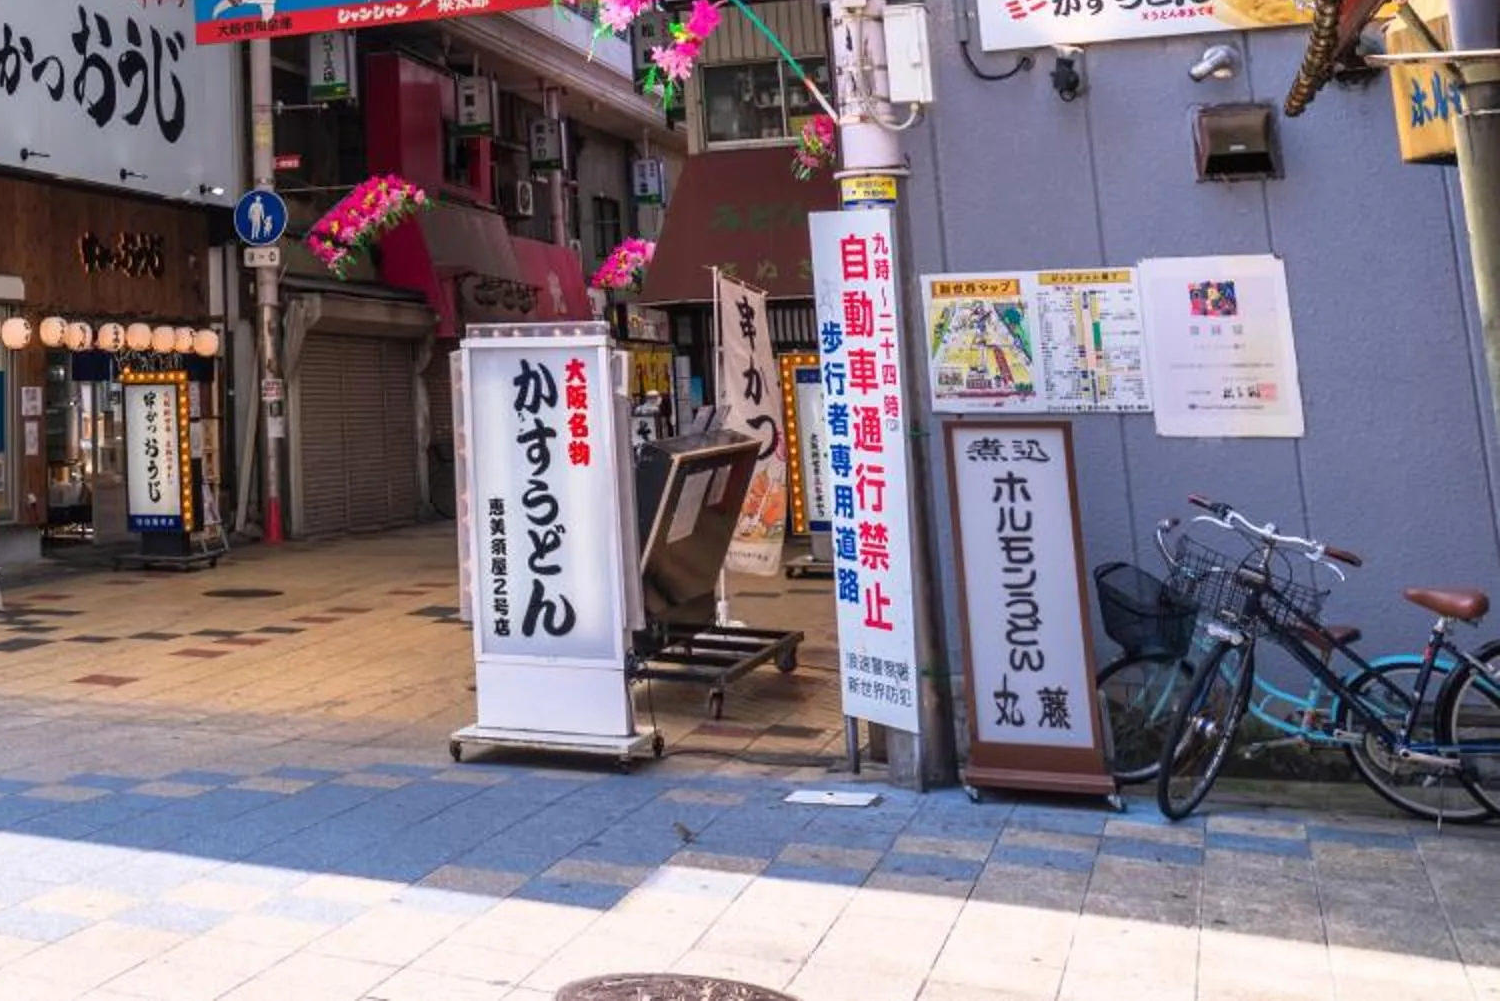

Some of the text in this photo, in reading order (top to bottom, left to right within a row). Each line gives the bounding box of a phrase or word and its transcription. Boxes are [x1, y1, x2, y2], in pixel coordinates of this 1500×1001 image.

[513, 358, 577, 638] かすうどん
[565, 357, 591, 467] 大阪名物
[820, 320, 860, 605] 歩行者専用道路
[840, 234, 894, 632] 自動車通行禁止
[965, 436, 1052, 463] 煮込
